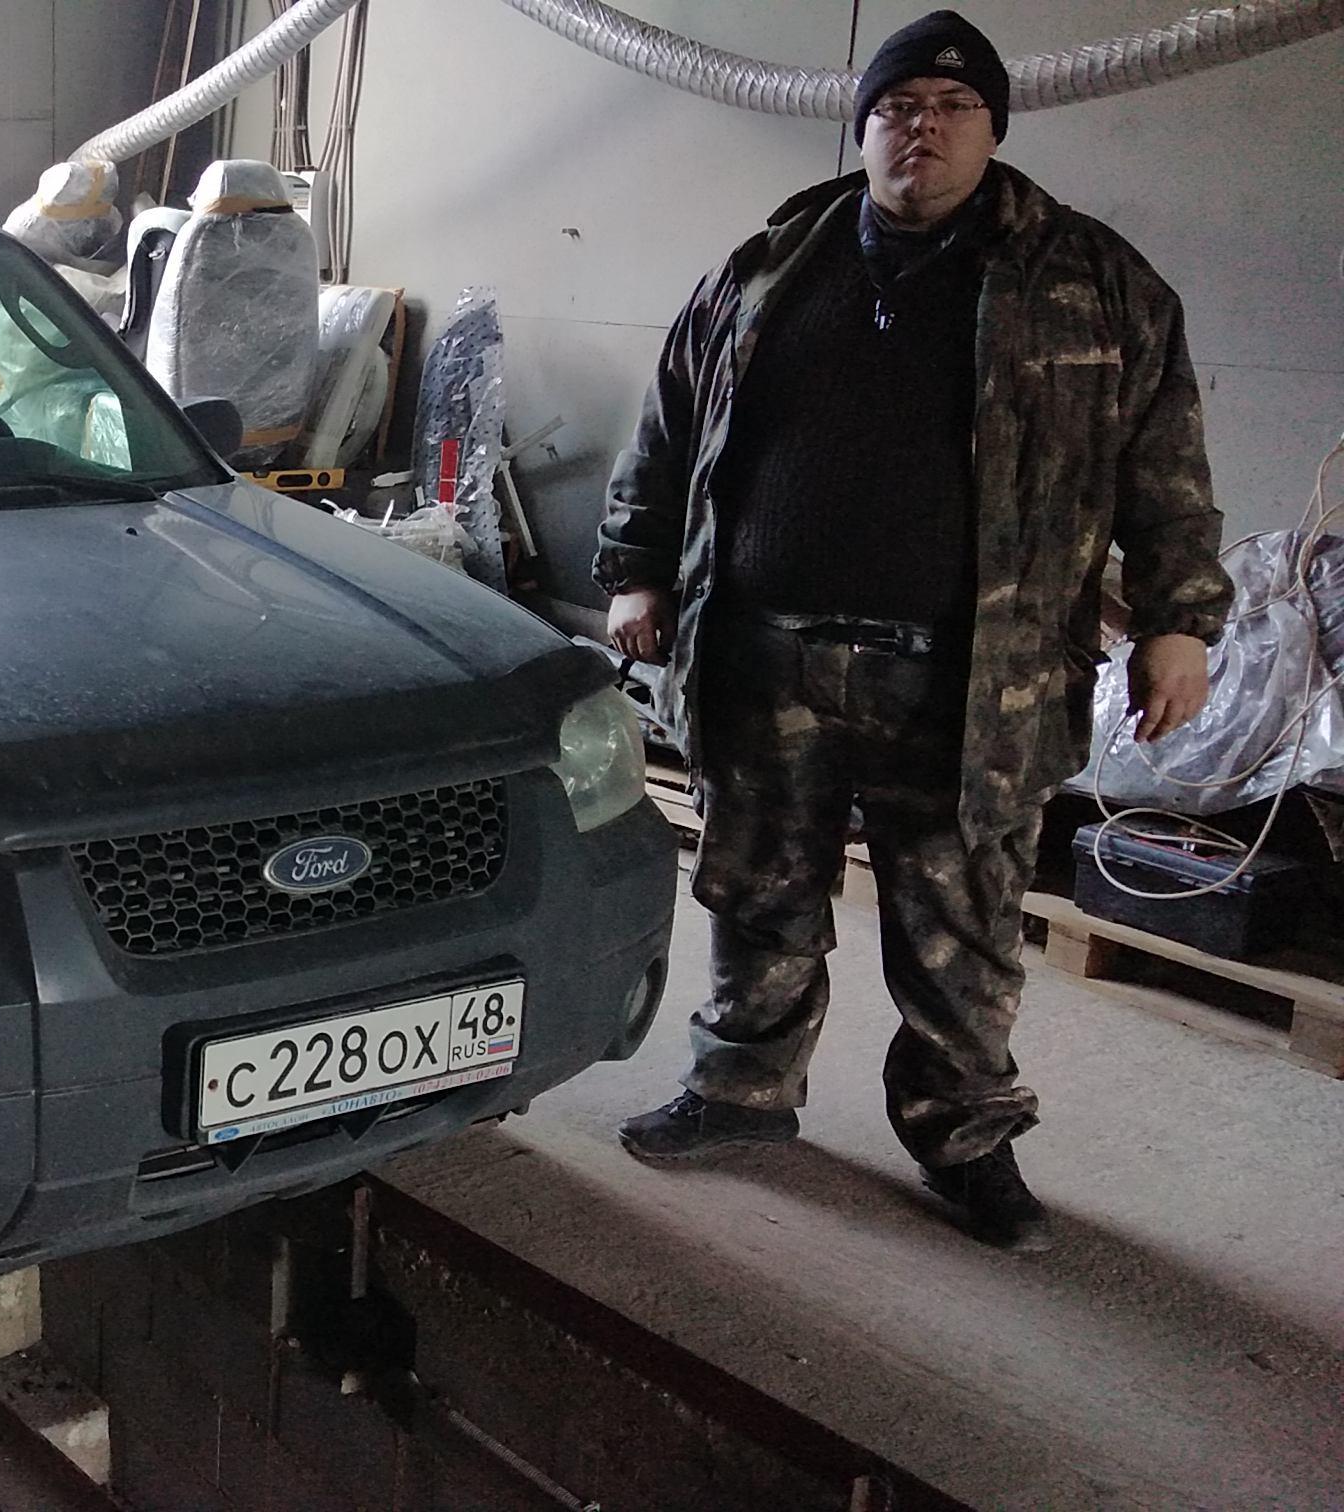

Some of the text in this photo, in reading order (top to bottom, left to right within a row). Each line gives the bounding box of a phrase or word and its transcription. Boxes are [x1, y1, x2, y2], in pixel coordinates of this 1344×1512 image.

[291, 846, 349, 881] Ford
[458, 993, 505, 1040] 48
[451, 1040, 487, 1062] RUS
